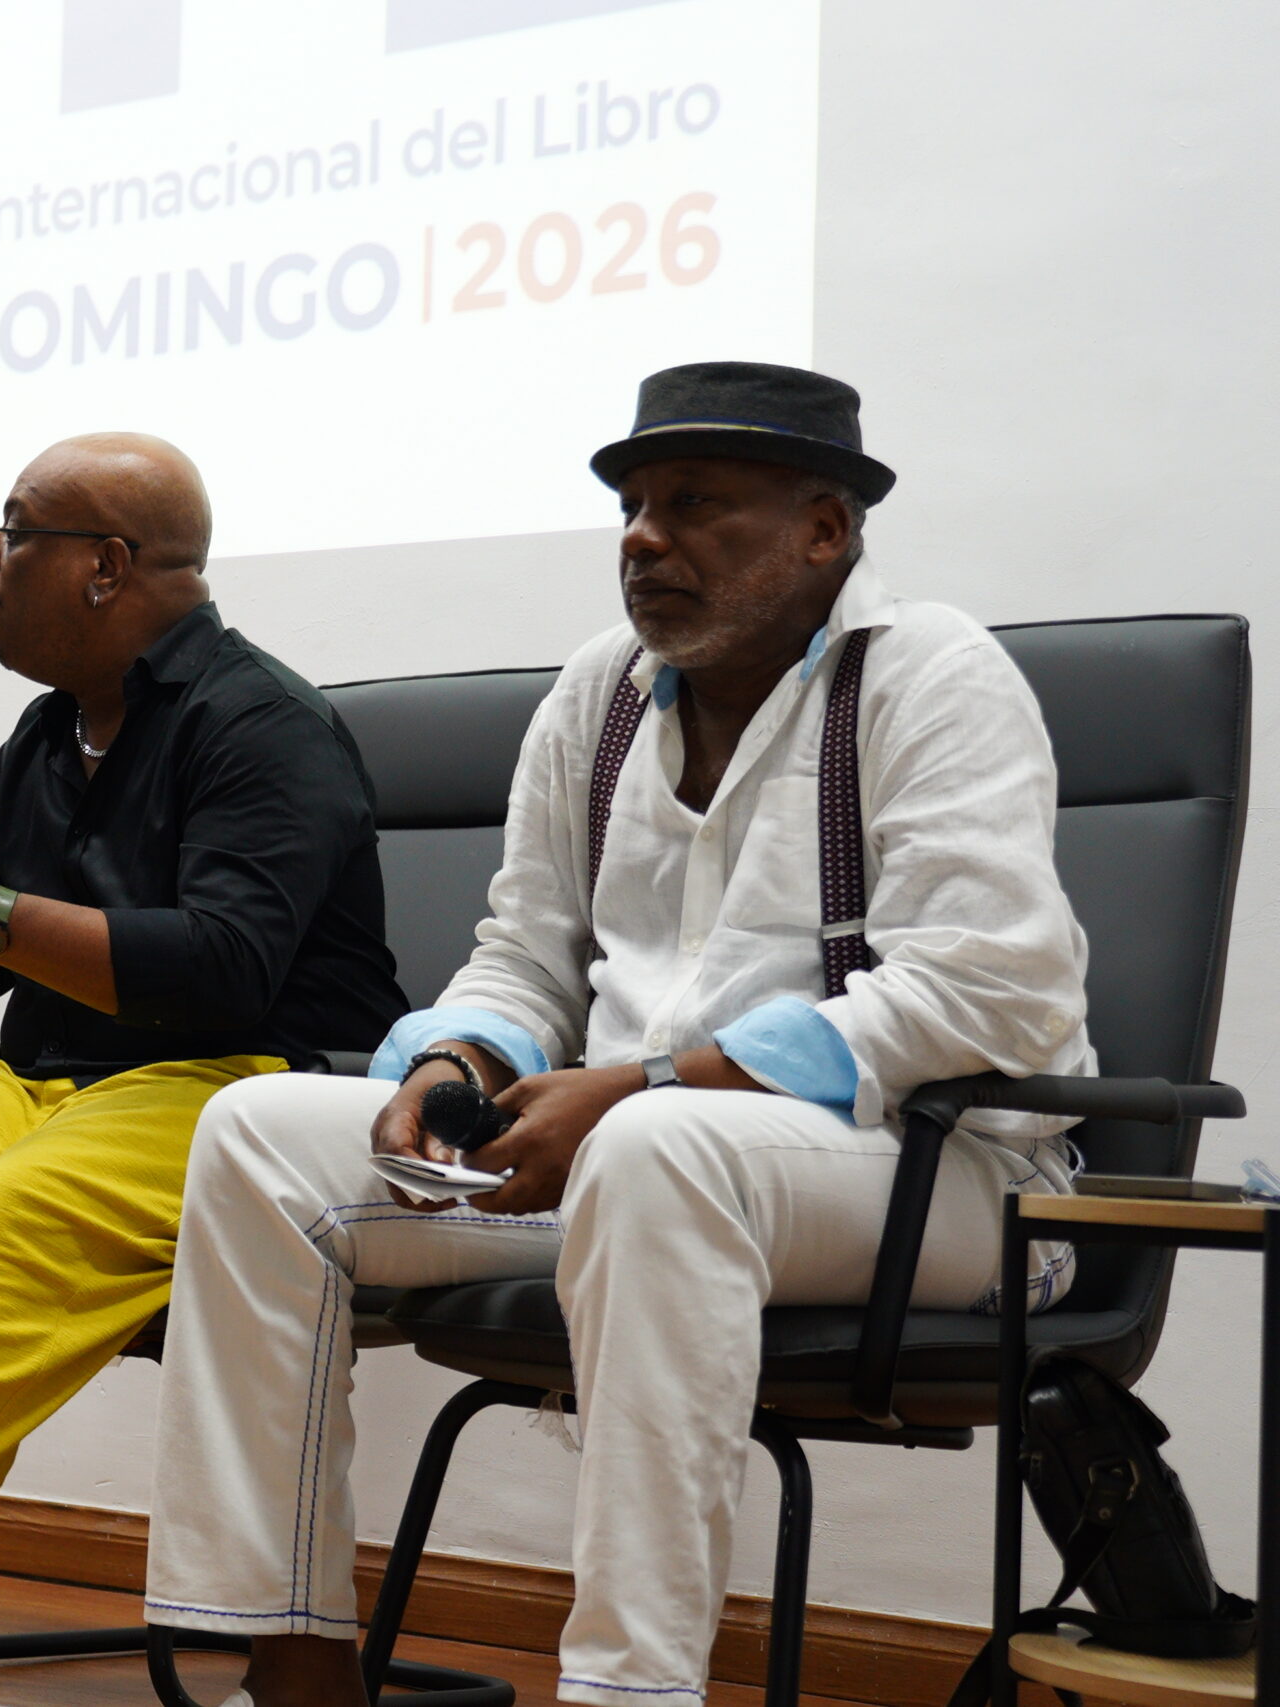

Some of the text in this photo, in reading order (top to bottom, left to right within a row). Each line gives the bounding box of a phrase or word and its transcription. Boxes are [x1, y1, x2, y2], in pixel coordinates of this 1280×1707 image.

[403, 96, 506, 178] del
[533, 81, 722, 159] Libro
[451, 190, 722, 314] 2026
